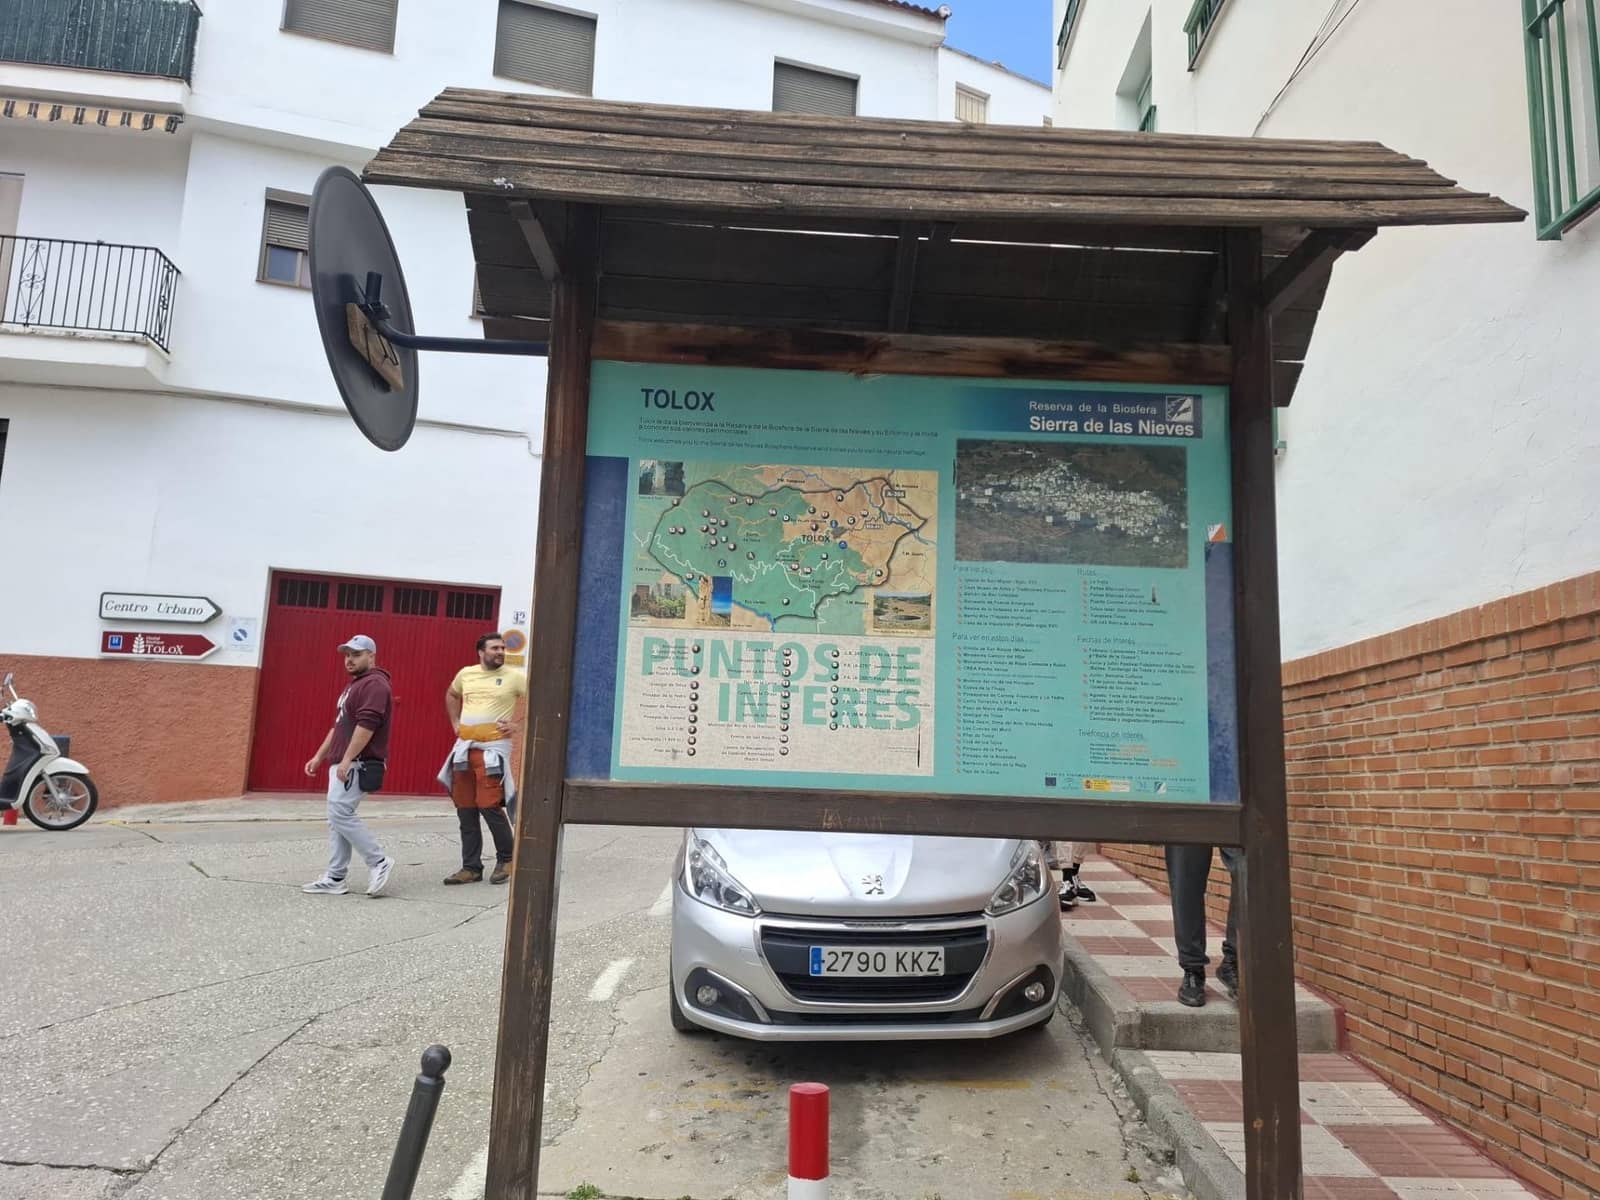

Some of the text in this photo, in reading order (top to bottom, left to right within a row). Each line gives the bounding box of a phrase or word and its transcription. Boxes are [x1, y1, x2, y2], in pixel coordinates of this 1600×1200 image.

[641, 388, 715, 411] TOLOX
[1029, 401, 1157, 415] Reserva de la Biosfera
[1029, 416, 1194, 436] Sierra de las Nieves
[801, 535, 831, 543] TOLOX
[105, 600, 203, 615] Centro Urbano
[641, 637, 840, 683] PUNTOS
[859, 645, 921, 685] DE
[717, 682, 921, 729] INTERES
[826, 951, 940, 973] 2790 KKZ
